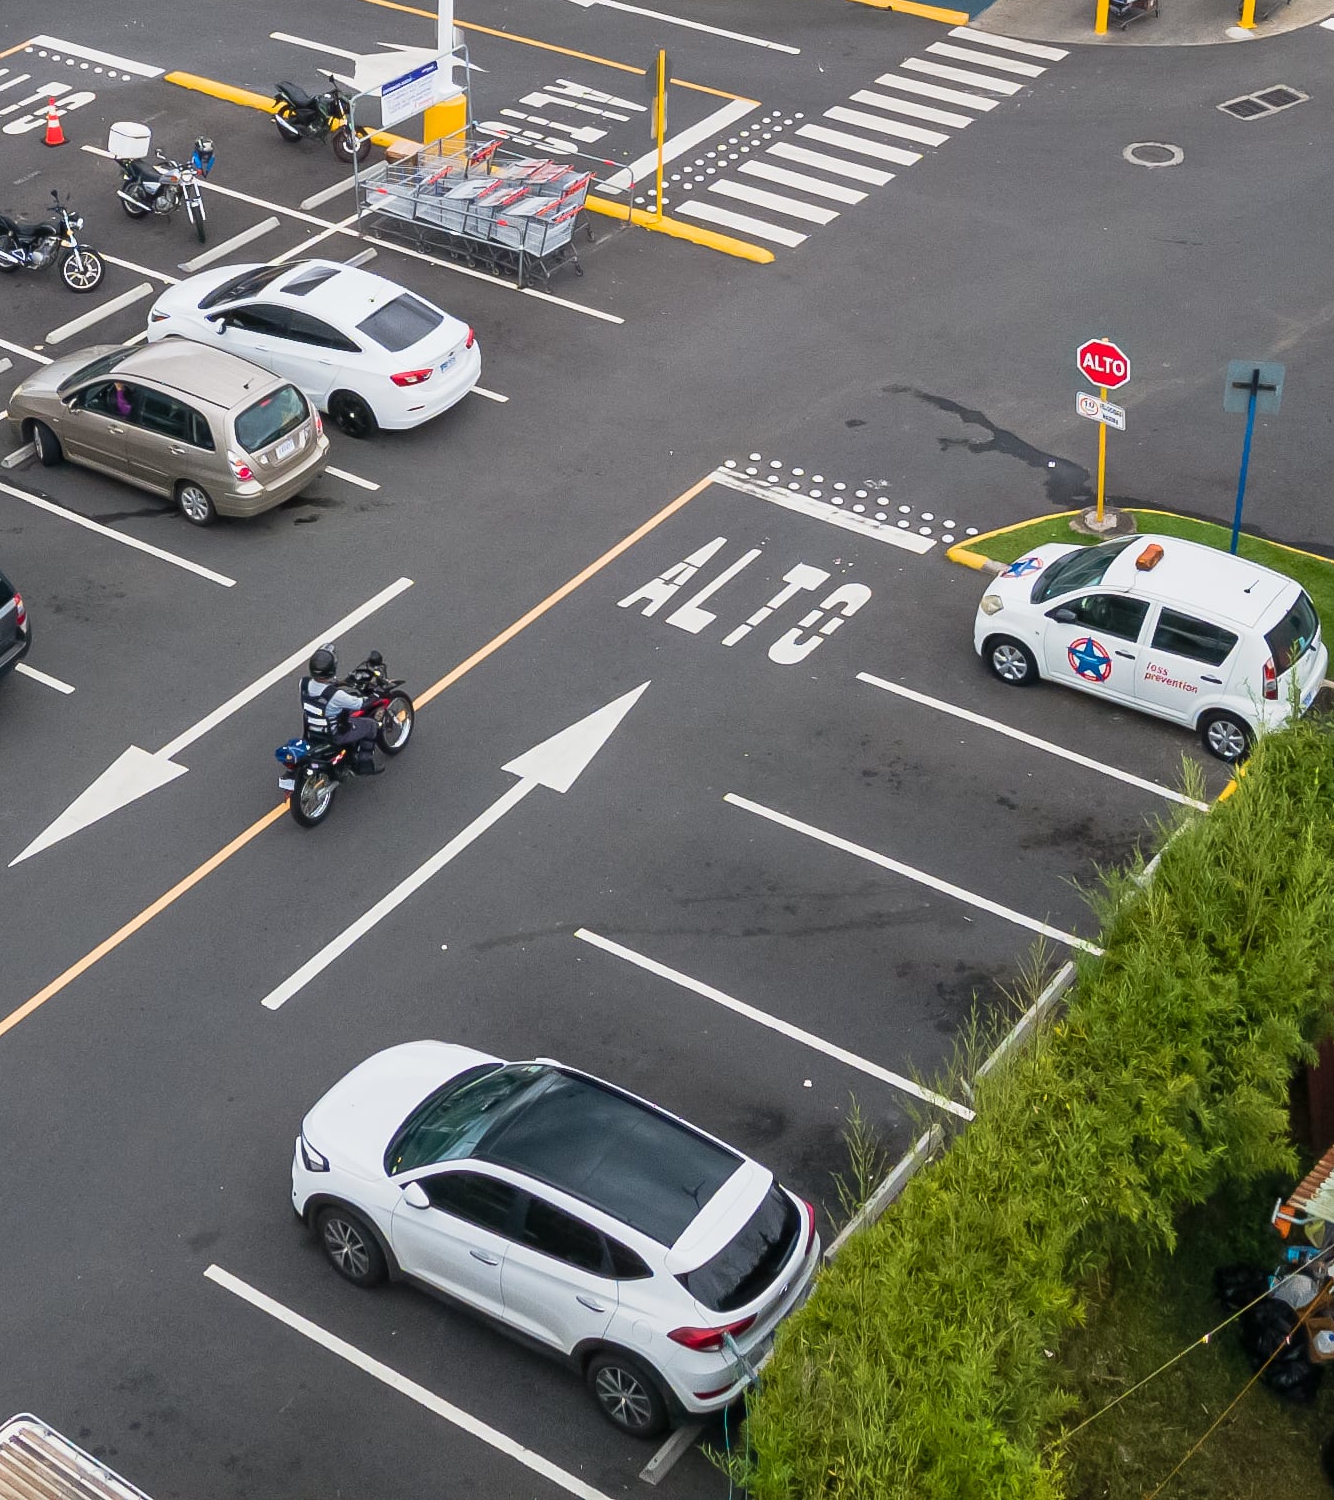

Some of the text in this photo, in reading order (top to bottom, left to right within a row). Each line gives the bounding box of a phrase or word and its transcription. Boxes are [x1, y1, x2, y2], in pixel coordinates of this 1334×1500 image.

[476, 78, 649, 155] ALTO
[1082, 352, 1126, 377] ALTO
[617, 536, 872, 665] ALTO
[1146, 661, 1169, 676] loss
[1144, 671, 1199, 694] prevention
